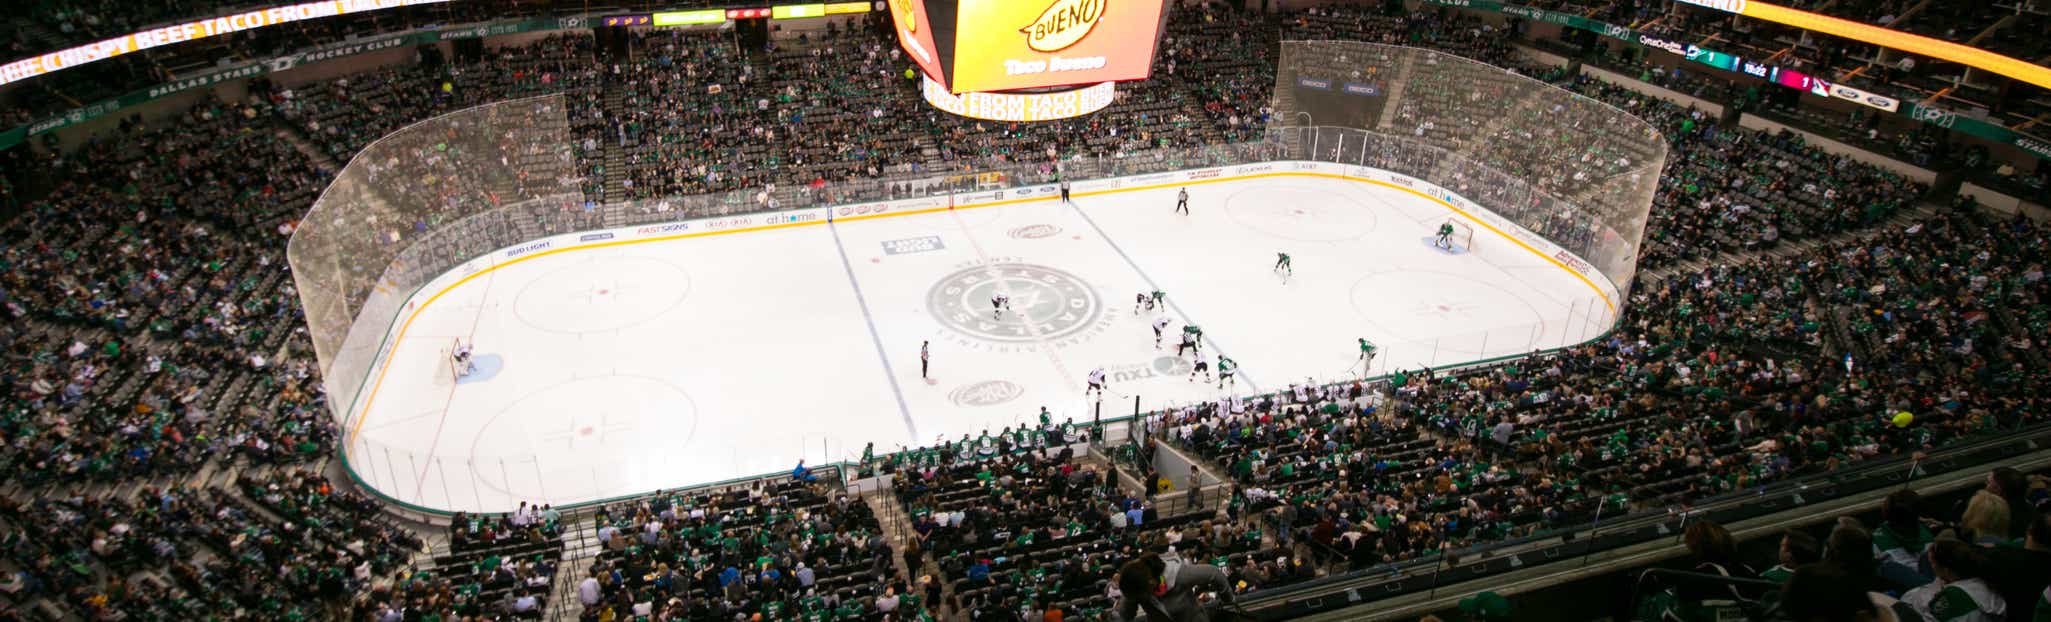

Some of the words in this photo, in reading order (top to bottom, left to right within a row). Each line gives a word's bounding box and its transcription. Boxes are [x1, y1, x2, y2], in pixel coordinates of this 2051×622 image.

[134, 24, 196, 49] BEEF
[201, 13, 262, 35] TACO
[267, 4, 337, 26] FROM
[1035, 0, 1098, 40] BUENO
[306, 45, 361, 62] HOCKEY
[367, 38, 400, 50] CLUB
[149, 77, 207, 97] DALLAS
[213, 64, 261, 82] STARS
[507, 247, 525, 257] BUD
[526, 241, 551, 252] LIGHT
